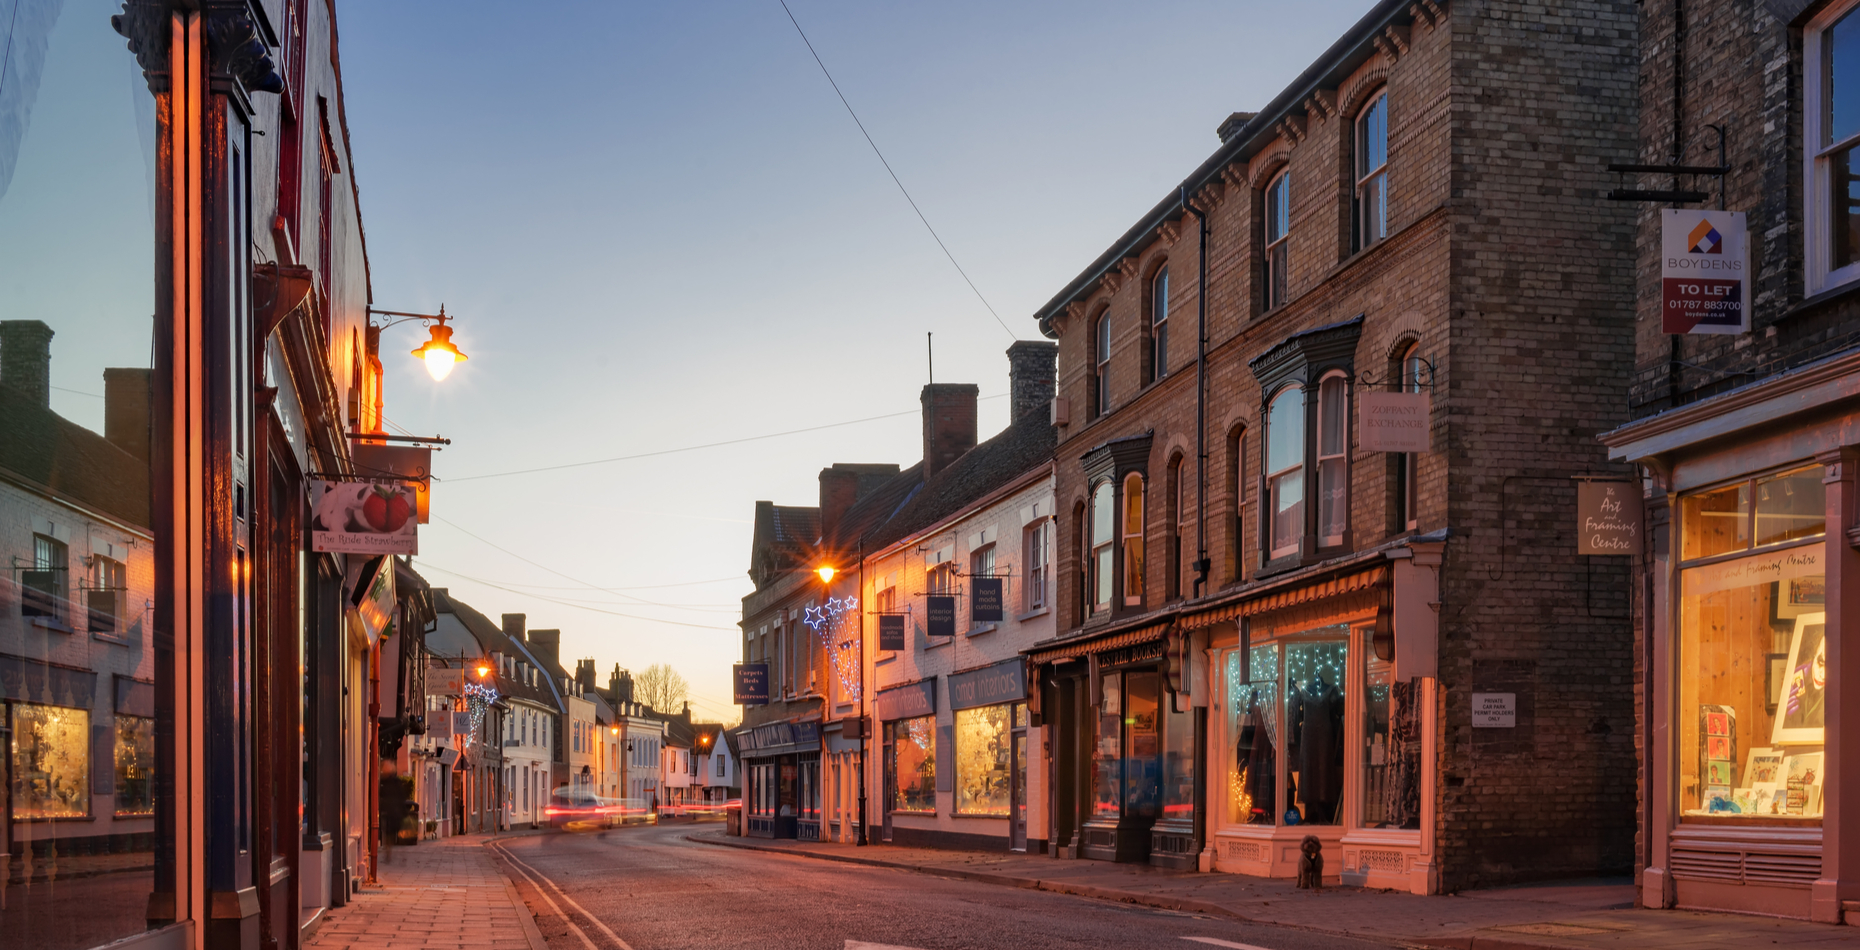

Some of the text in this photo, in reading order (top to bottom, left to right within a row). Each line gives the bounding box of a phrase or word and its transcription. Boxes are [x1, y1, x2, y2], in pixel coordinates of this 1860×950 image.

[1668, 258, 1742, 271] BOYDENS
[1678, 284, 1733, 296] TO LET
[1669, 299, 1741, 310] 01787 883700
[1371, 405, 1418, 415] ZOFFANY
[1367, 419, 1423, 429] EXCHANGE
[1606, 487, 1615, 496] The
[1600, 497, 1622, 512] Art
[1585, 516, 1637, 537] Framing
[317, 533, 414, 548] The Rude Strawberry
[1591, 534, 1631, 549] Centre
[1746, 559, 1782, 577] Framing
[979, 588, 996, 596] hand
[929, 614, 952, 623] design
[977, 671, 1016, 698] interiors
